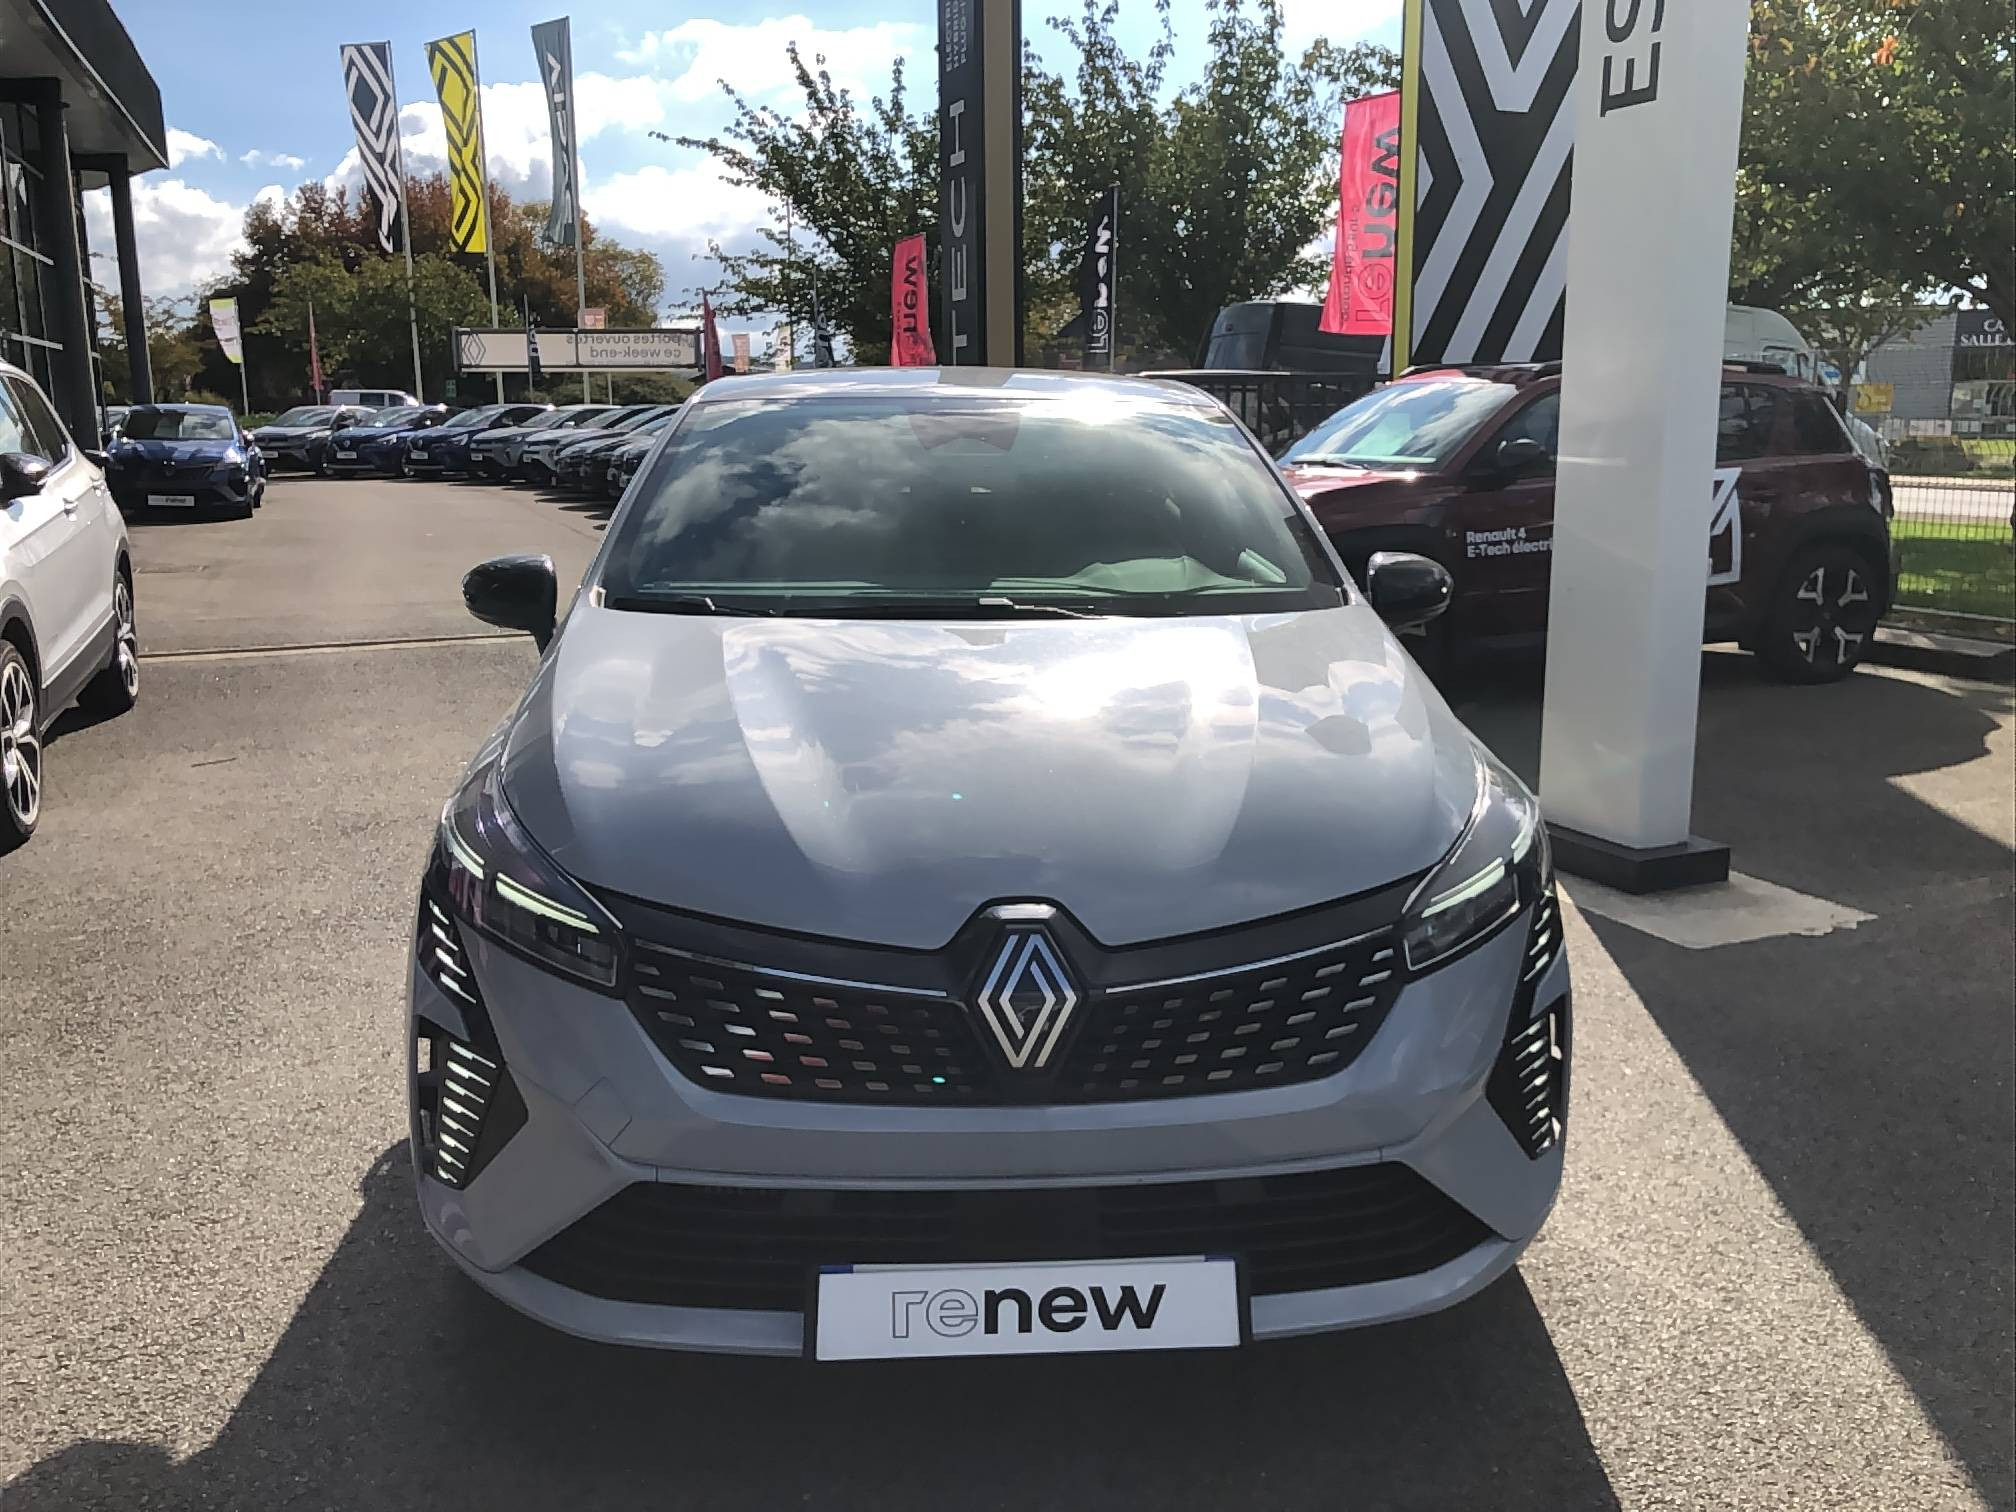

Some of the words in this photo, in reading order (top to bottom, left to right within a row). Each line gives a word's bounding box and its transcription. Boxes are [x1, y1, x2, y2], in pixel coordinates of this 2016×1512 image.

[949, 99, 968, 367] TECH
[1466, 527, 1517, 543] Renault
[1518, 527, 1526, 539] 4
[1467, 541, 1511, 557] E-Tech
[892, 1284, 1167, 1338] renew
